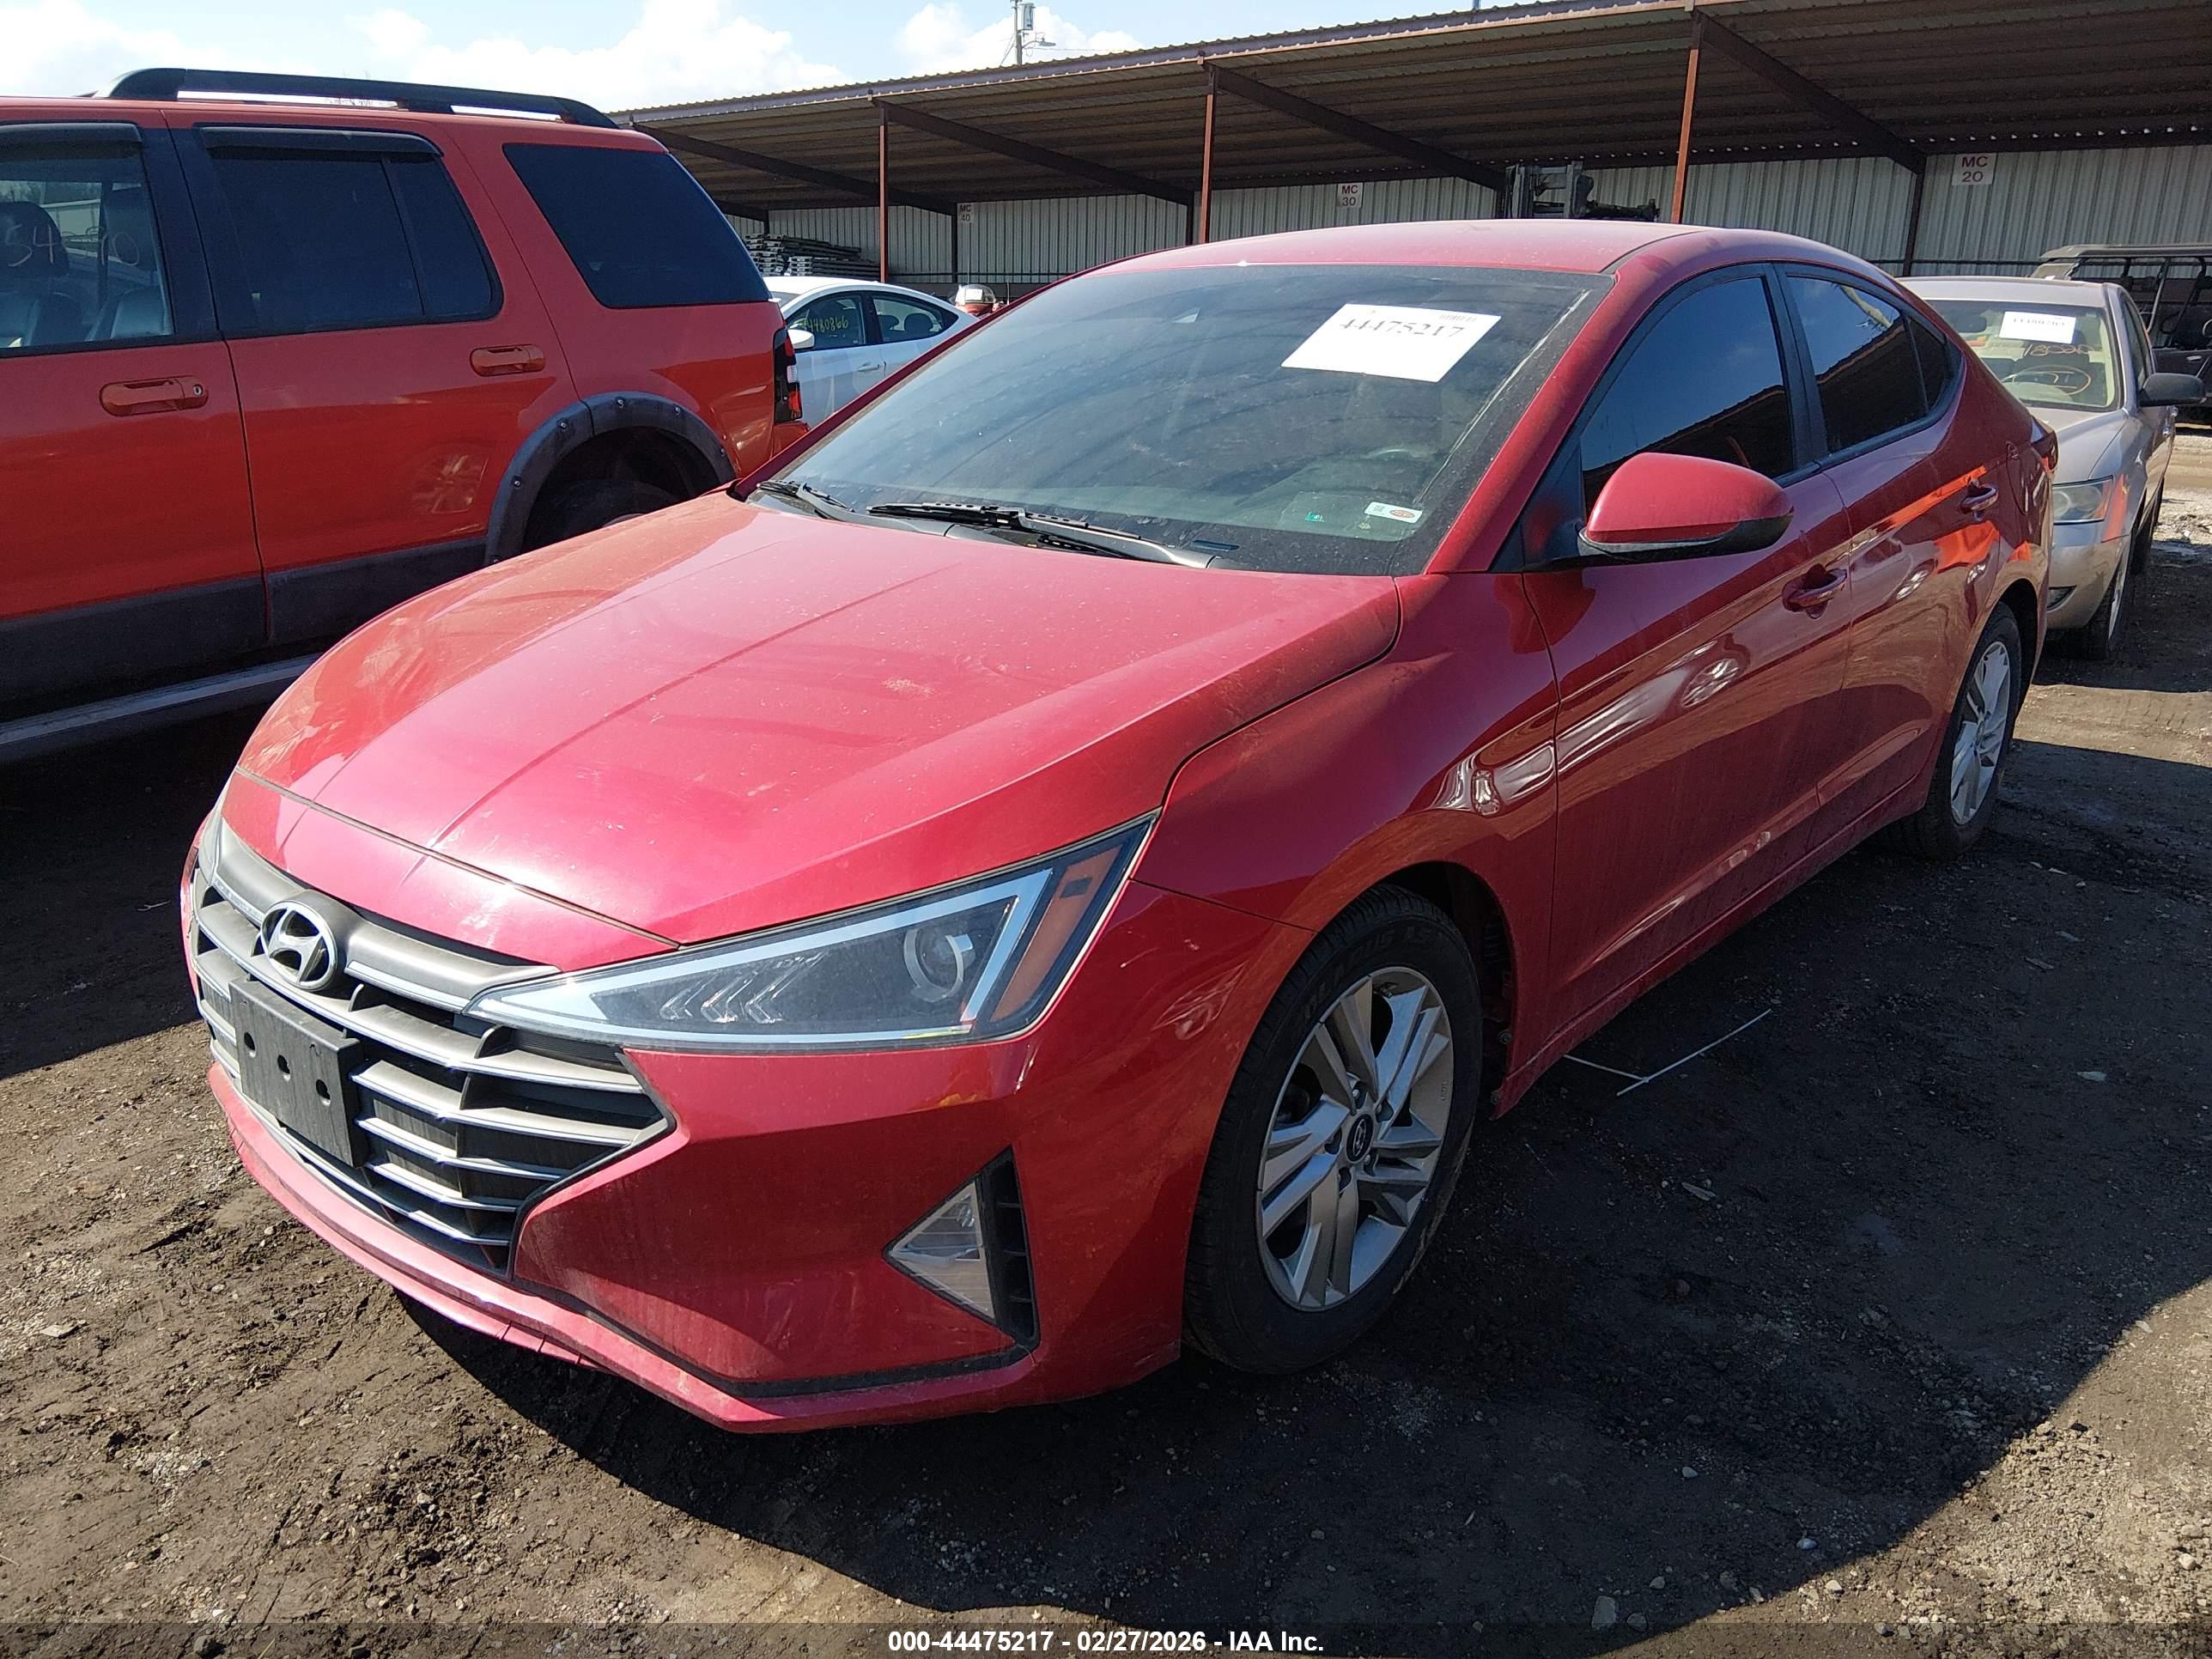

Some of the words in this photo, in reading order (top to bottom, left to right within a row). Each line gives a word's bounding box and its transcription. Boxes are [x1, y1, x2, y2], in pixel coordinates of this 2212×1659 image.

[1961, 155, 1988, 167] MC
[1962, 171, 1984, 183] 20
[1341, 185, 1358, 195] MC
[1342, 197, 1357, 207] 30
[960, 204, 972, 213] MC
